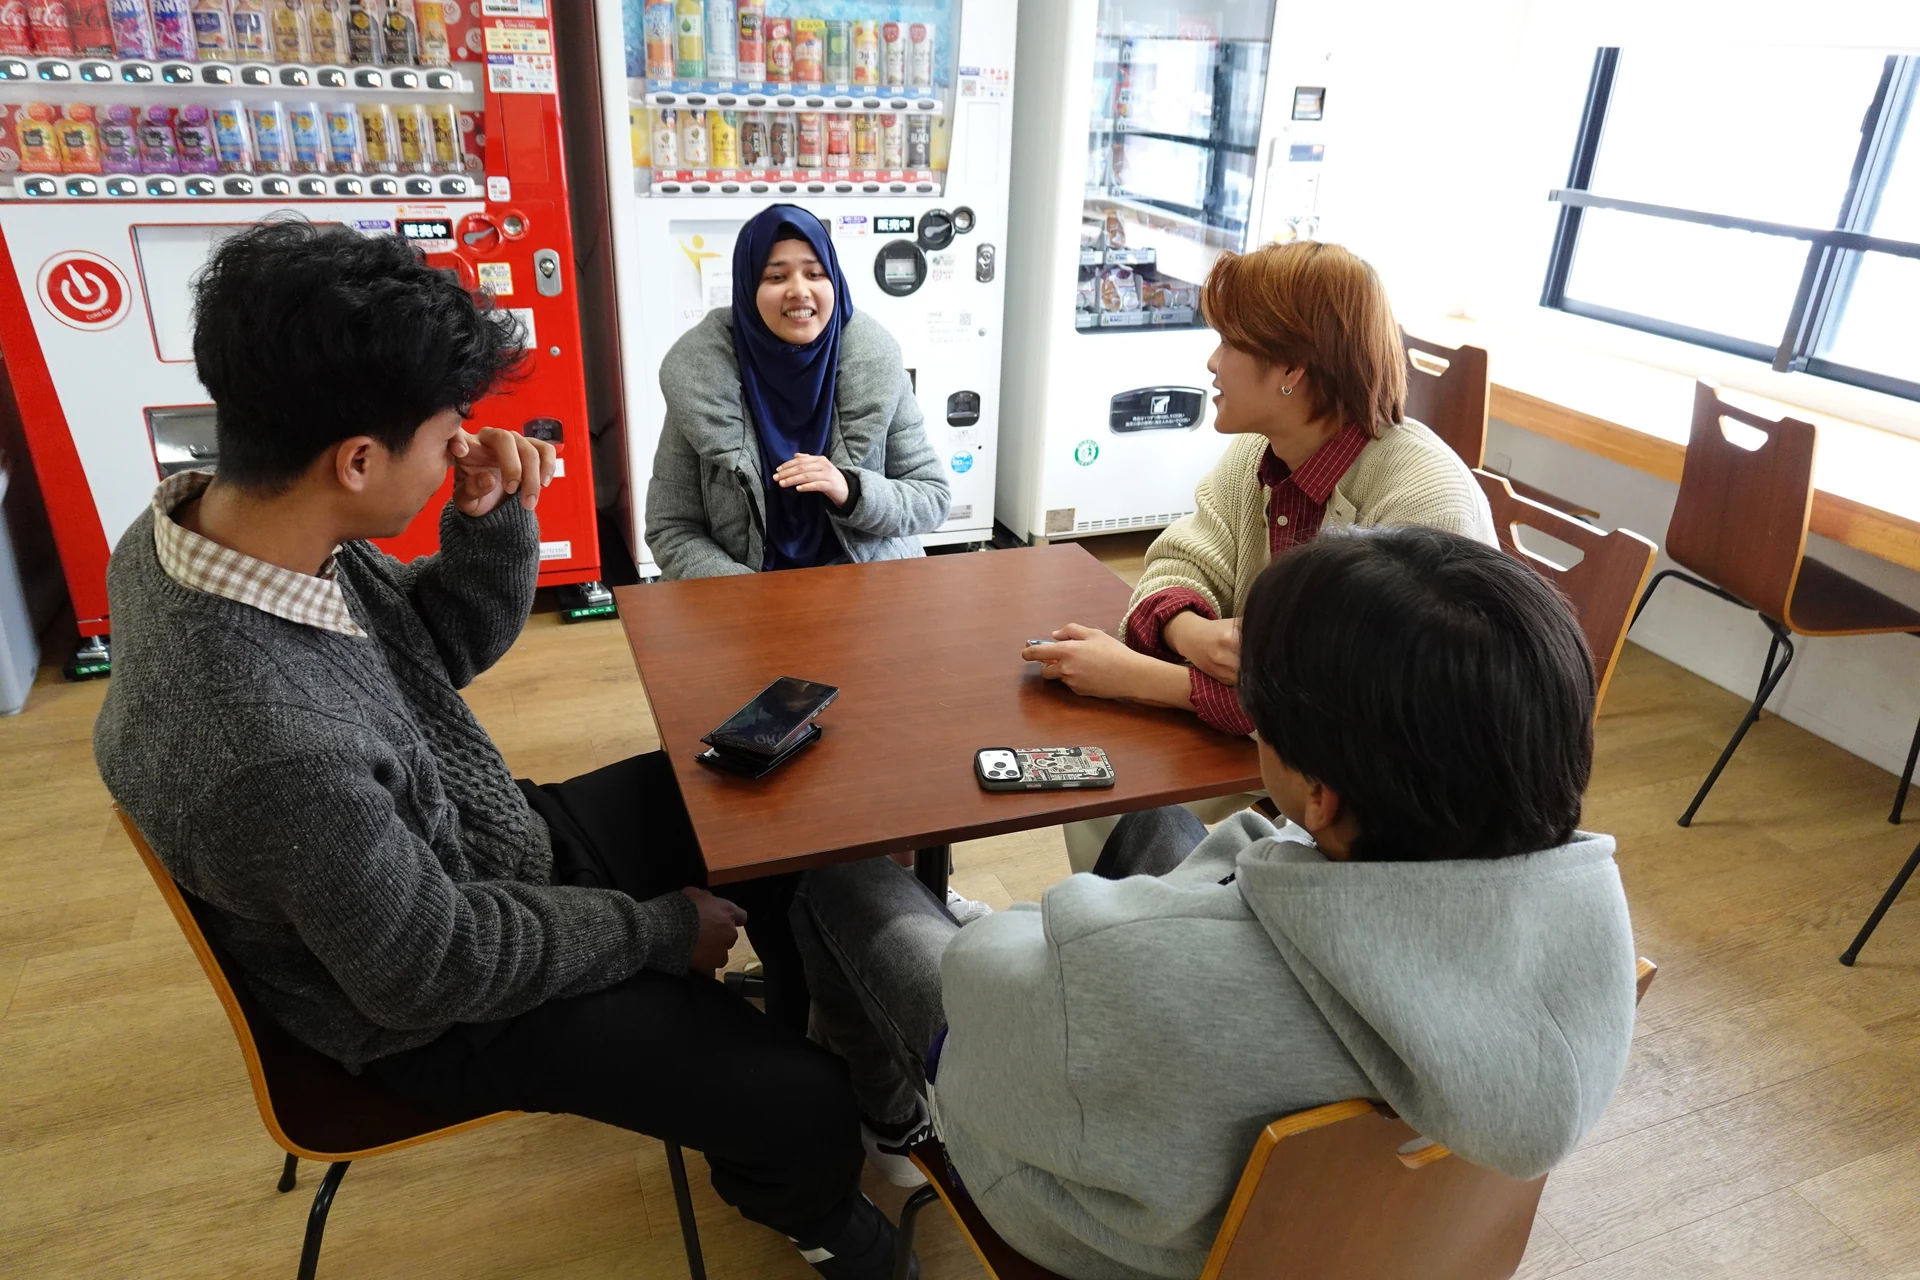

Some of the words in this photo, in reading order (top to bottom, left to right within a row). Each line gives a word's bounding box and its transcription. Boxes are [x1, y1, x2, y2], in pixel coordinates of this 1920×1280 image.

[404, 223, 447, 238] 販売中
[877, 218, 911, 232] 販売中
